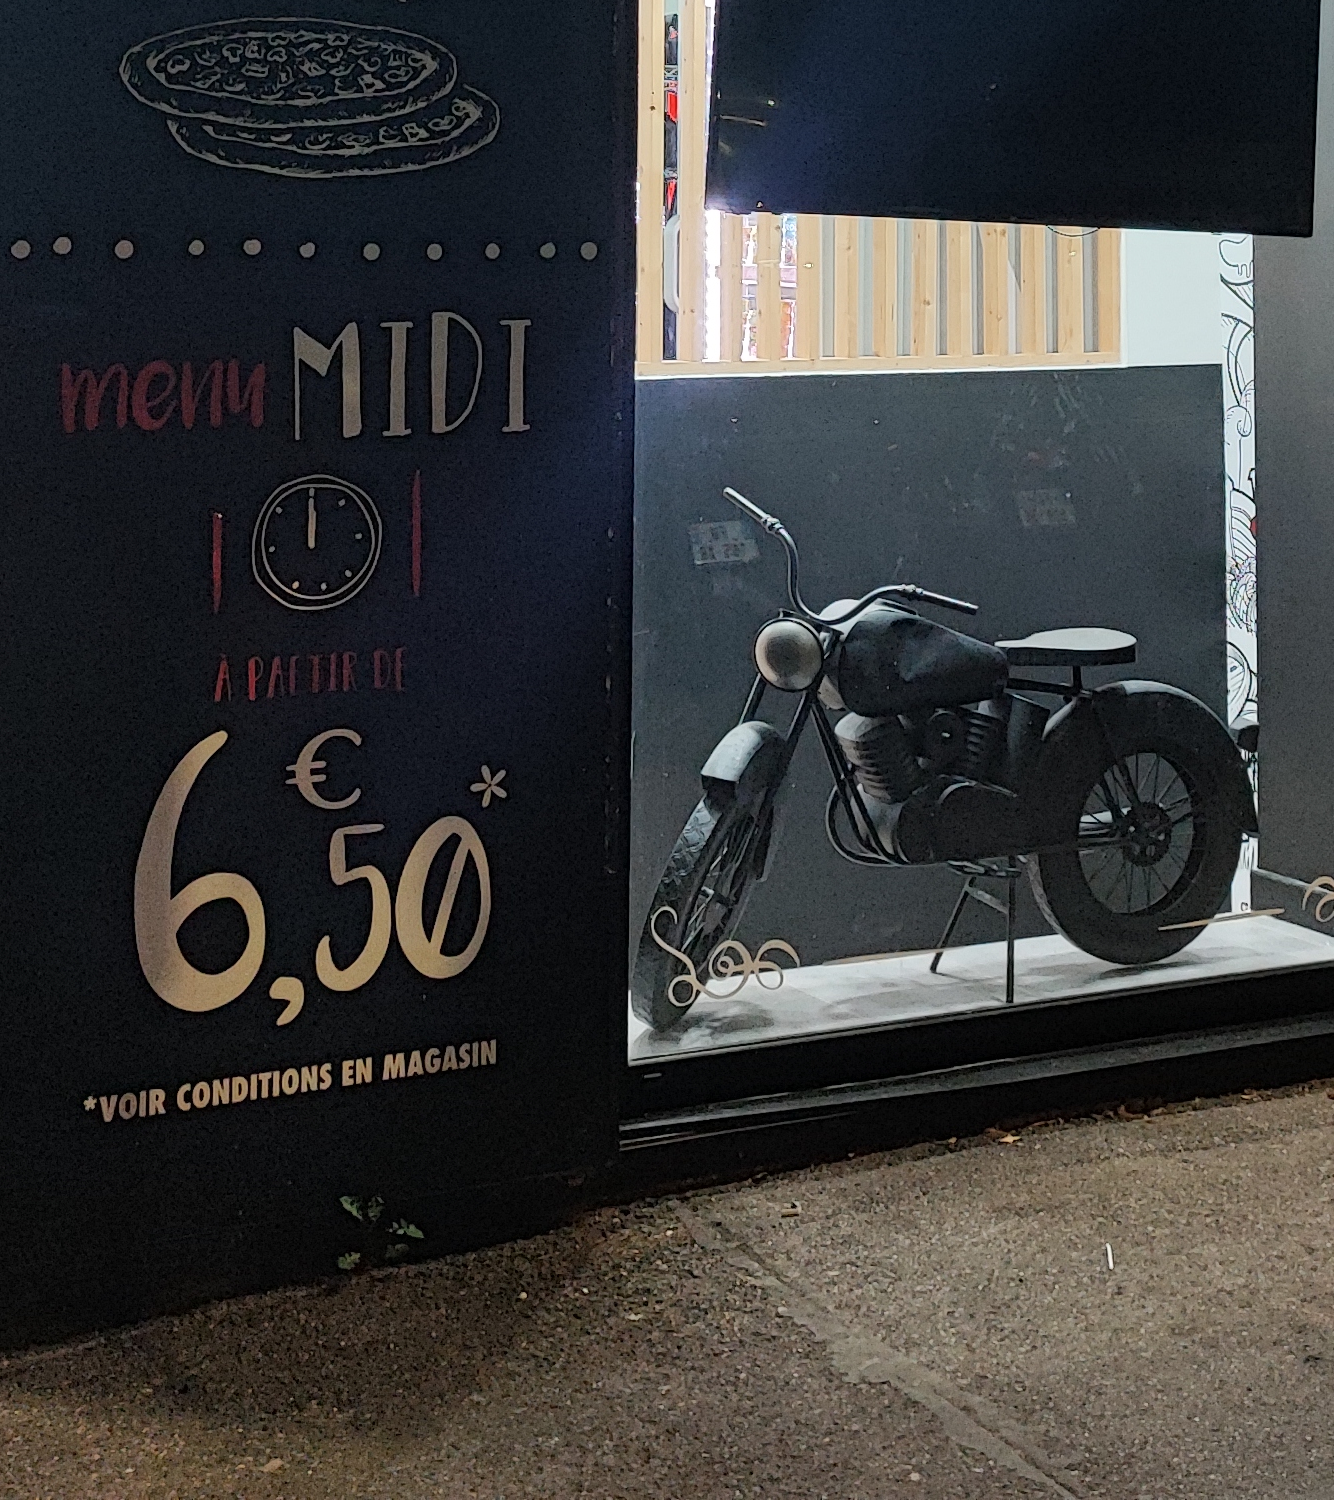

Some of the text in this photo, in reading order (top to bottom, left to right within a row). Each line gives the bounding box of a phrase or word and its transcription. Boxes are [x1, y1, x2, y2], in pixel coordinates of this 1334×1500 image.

[61, 312, 533, 441] menu MIDI
[284, 729, 362, 809] €
[176, 1062, 331, 1112] CONDITIONS
[341, 1057, 373, 1087] EN
[383, 1038, 498, 1081] MAGASIN
